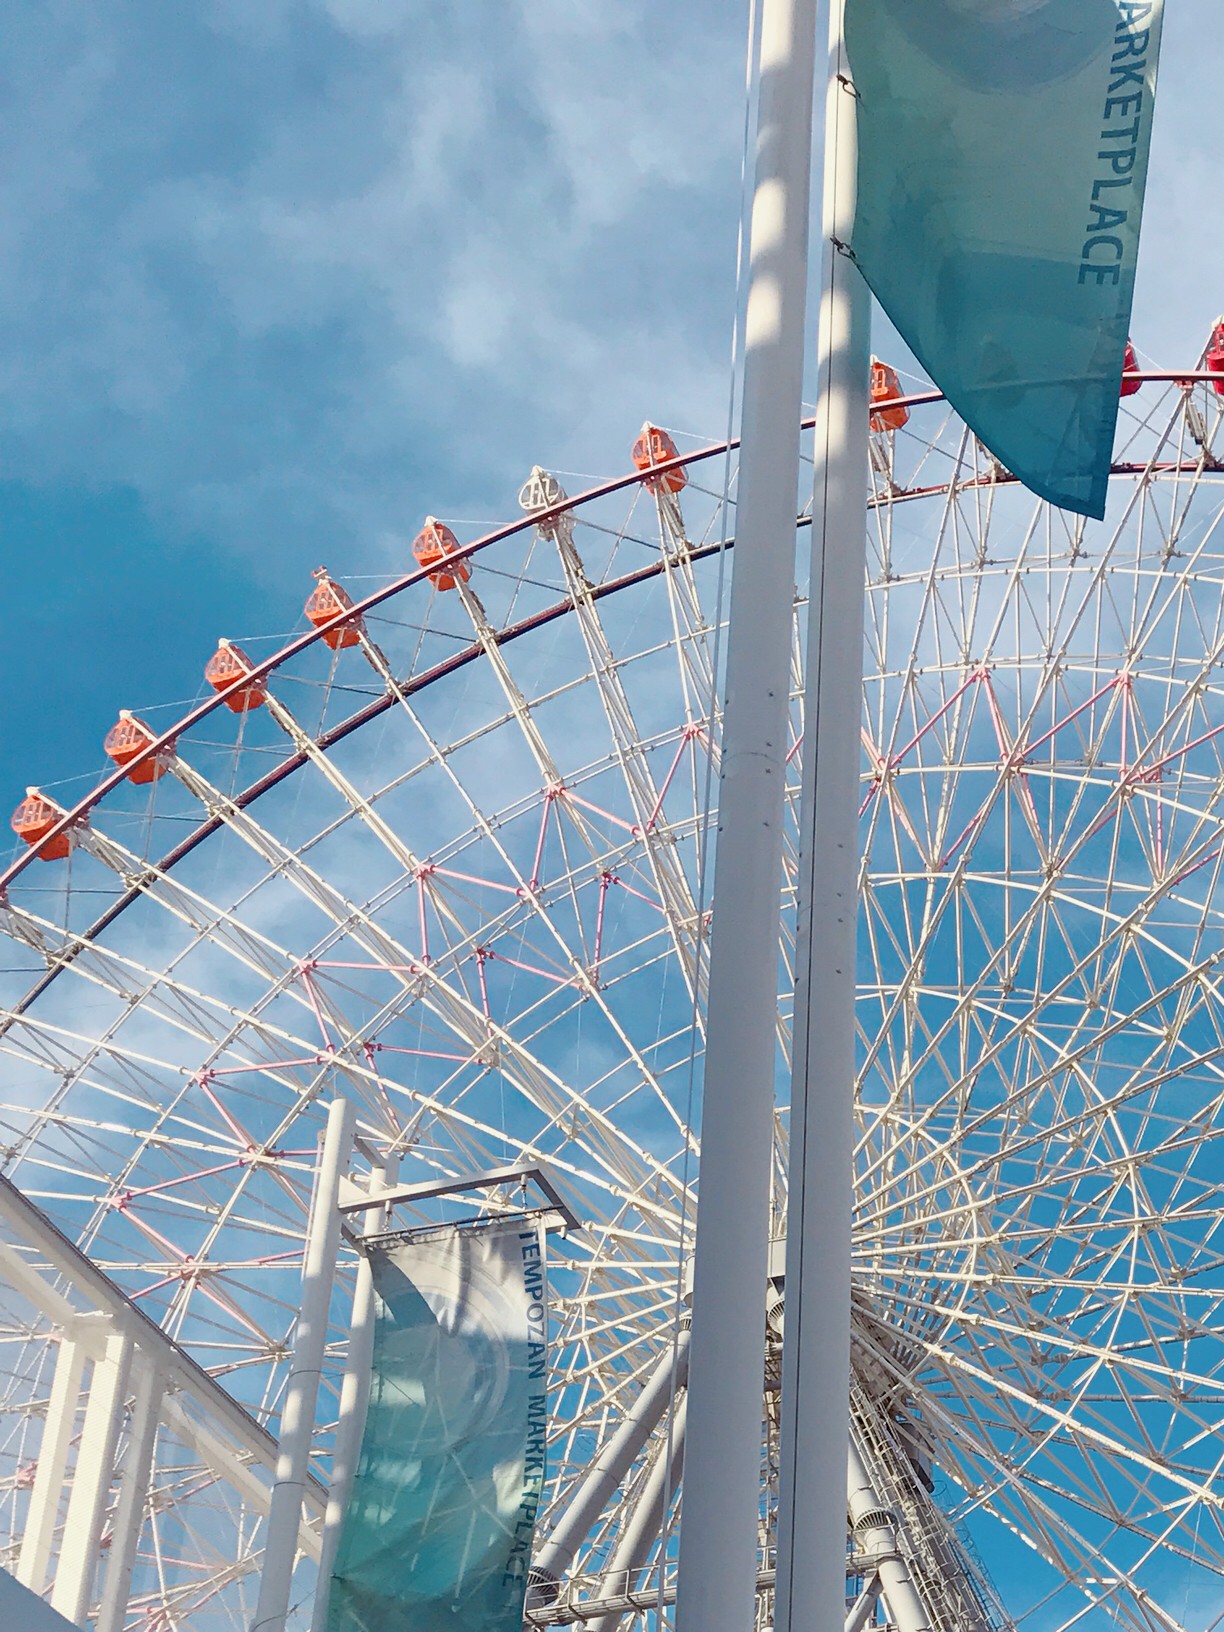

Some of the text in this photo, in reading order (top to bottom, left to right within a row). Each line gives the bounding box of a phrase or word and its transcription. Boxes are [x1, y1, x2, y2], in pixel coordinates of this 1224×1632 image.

[1077, 0, 1152, 286] ARKETPLACE
[502, 1231, 546, 1588] TEMPOZAN MARKETPLACE
